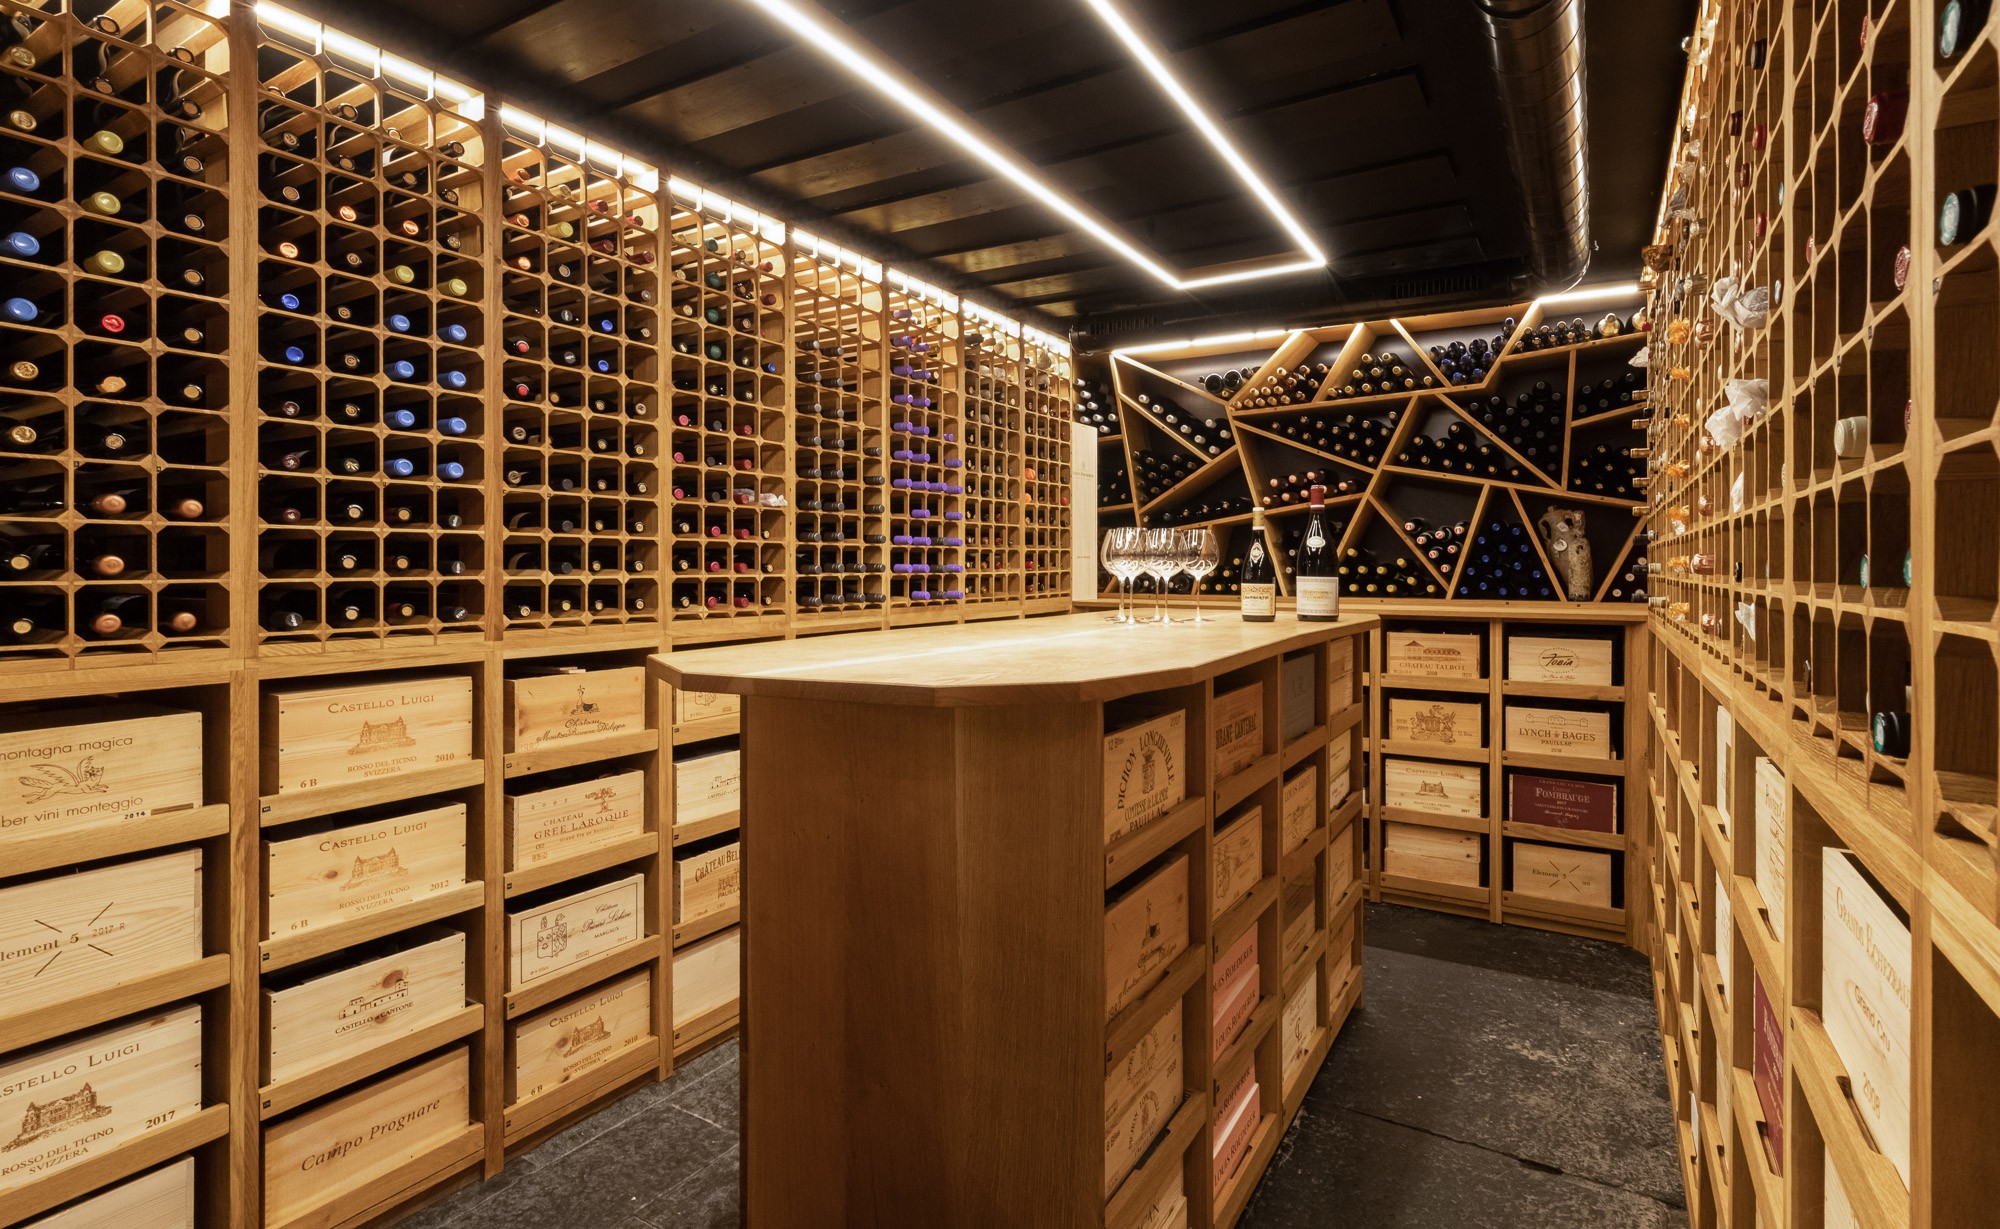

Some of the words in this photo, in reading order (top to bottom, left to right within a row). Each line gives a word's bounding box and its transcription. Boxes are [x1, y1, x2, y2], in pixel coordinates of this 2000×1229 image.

[327, 699, 395, 714] CASTELLO
[401, 695, 435, 706] LUIGI
[1519, 728, 1551, 738] LYNCH
[1562, 731, 1596, 741] BAGES
[79, 737, 133, 752] magica
[347, 763, 374, 773] ROSSO
[374, 760, 389, 768] DEL
[389, 756, 417, 766] TICINO
[434, 752, 455, 764] 2010
[363, 766, 401, 778] SVIZZERA
[1117, 748, 1138, 810] PICHON
[300, 779, 307, 789] 6
[309, 778, 317, 787] B
[34, 808, 60, 821] vini
[66, 796, 143, 817] monteggio
[124, 811, 146, 820] 2014
[543, 812, 584, 827] CHATEAU
[571, 809, 629, 830] LAROQUE
[318, 831, 387, 852] CASTELLO
[393, 821, 428, 836] LUIGI
[429, 880, 449, 892] 2012
[355, 897, 394, 913] SVIZZERA
[69, 933, 80, 944] 5
[92, 925, 114, 937] 2017
[290, 921, 298, 931] 6
[300, 919, 308, 928] B
[335, 1016, 373, 1034] CASTELLO
[380, 1001, 414, 1018] CANTONE
[549, 1003, 596, 1028] CASTELLO
[599, 991, 624, 1006] LUIGI
[1854, 985, 1876, 1028] Grand
[1877, 1019, 1890, 1052] Cru
[87, 1043, 140, 1067] LUIGI
[144, 1109, 176, 1130] 2017
[301, 1136, 363, 1172] Campo
[369, 1099, 441, 1141] Prognare
[1, 1154, 43, 1176] ROSSO
[46, 1144, 71, 1159] DEL
[73, 1127, 114, 1148] TICINO
[28, 1147, 89, 1175] SVIZZERA
